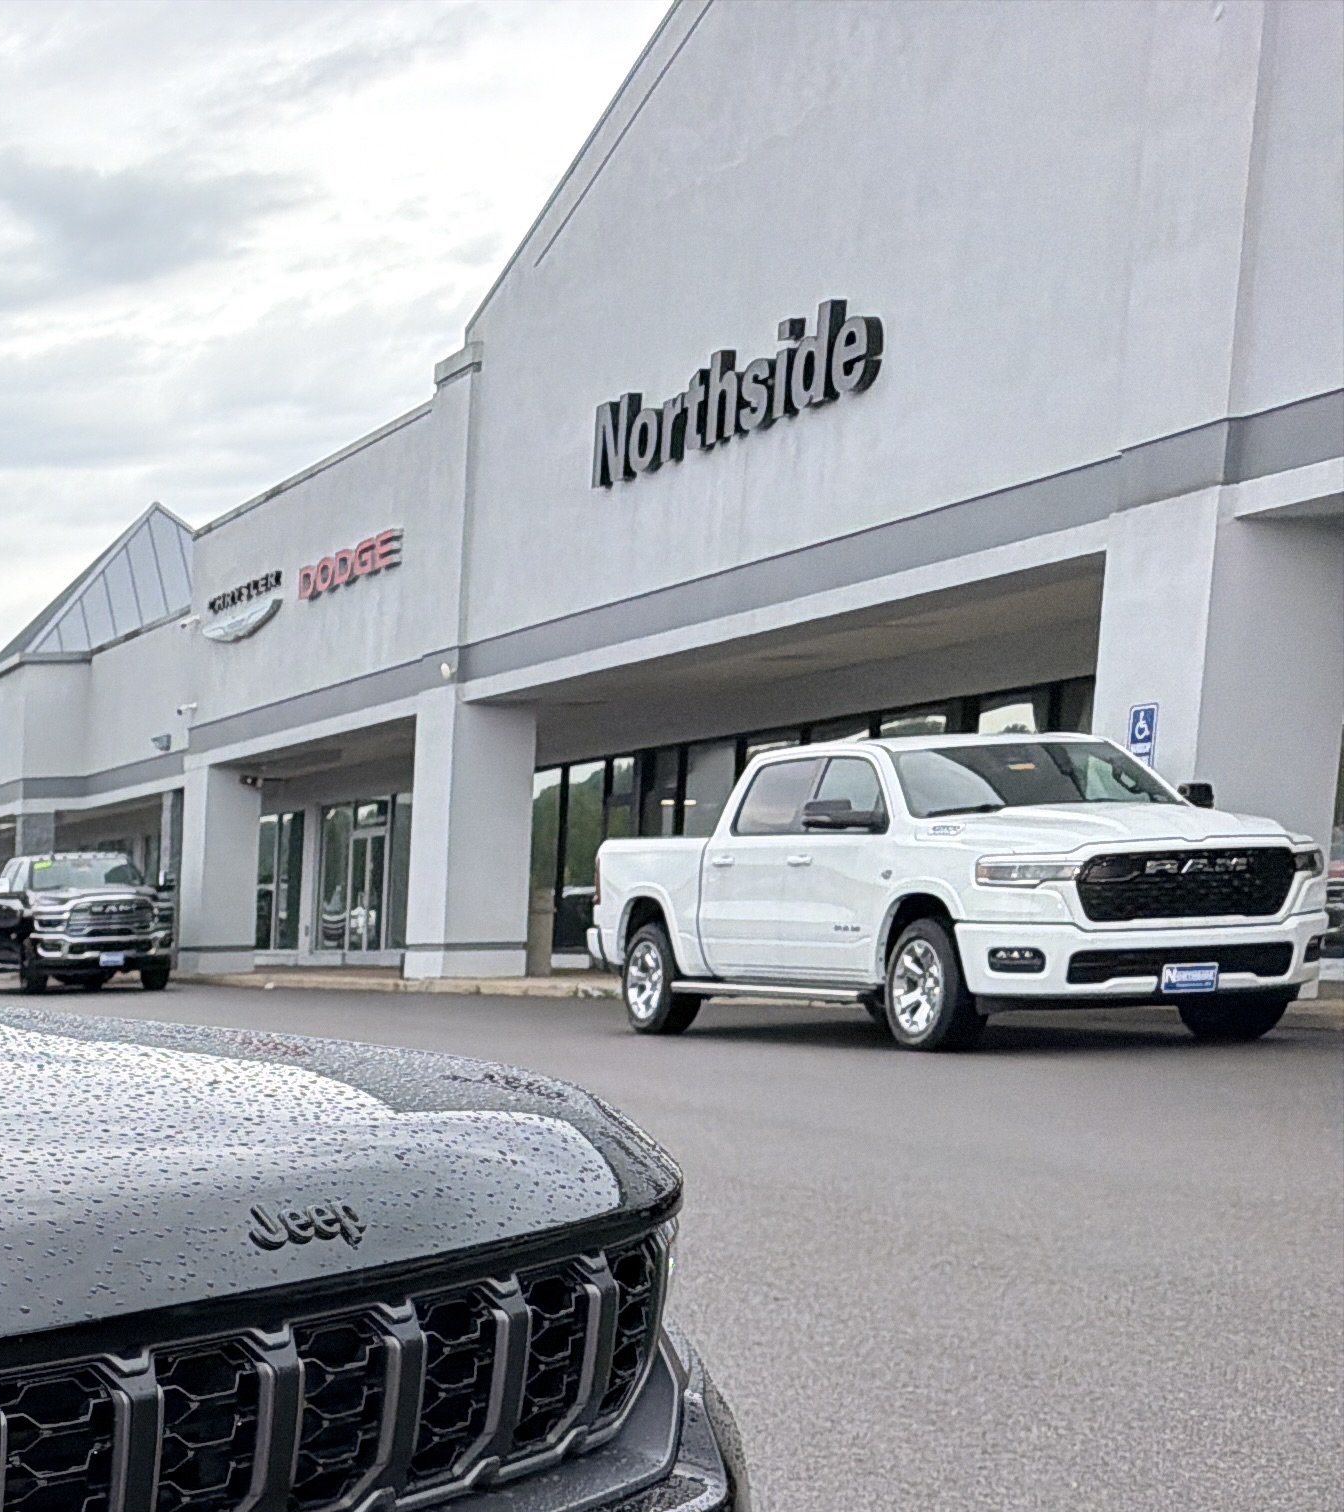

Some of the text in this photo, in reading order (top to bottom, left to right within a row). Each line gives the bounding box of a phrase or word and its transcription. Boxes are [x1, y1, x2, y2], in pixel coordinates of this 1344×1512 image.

[591, 298, 884, 489] Northside
[298, 528, 404, 602] DODGE
[248, 1202, 368, 1251] Jeep
